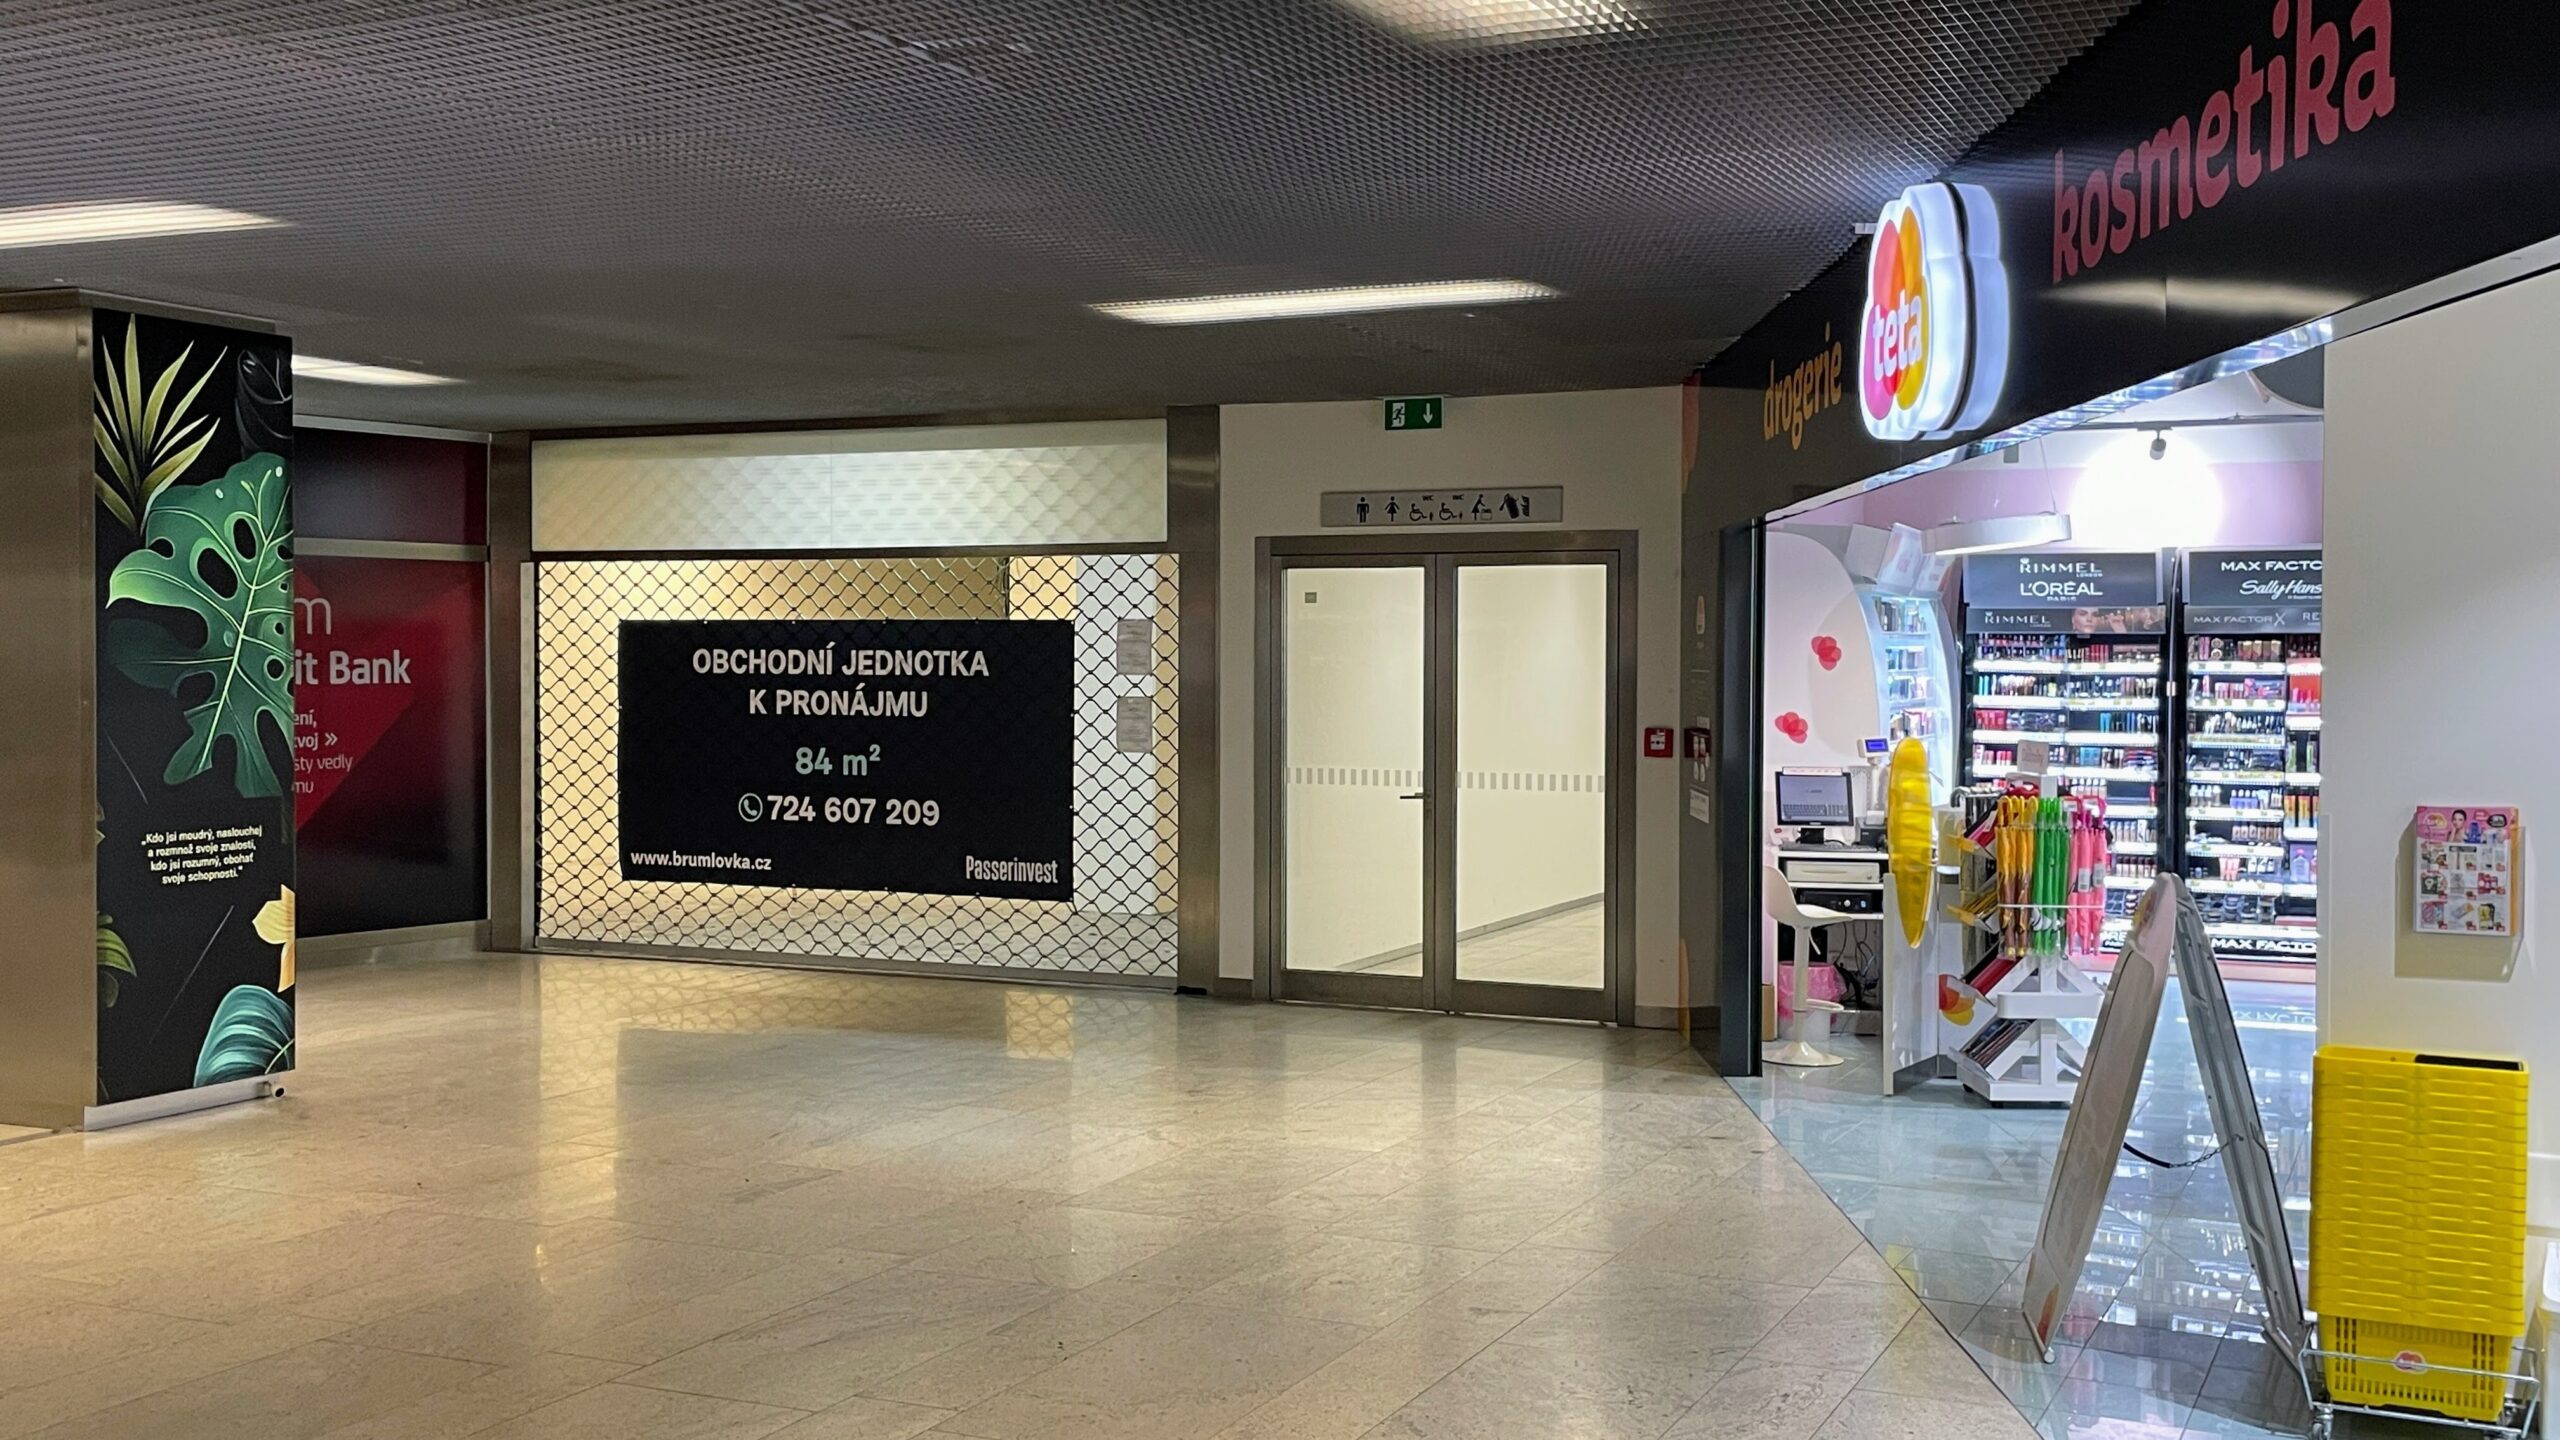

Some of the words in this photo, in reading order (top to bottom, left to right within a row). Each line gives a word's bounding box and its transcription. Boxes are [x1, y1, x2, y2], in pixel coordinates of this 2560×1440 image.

[2053, 0, 2396, 285] kosmetika
[1872, 289, 1923, 382] teta
[1763, 321, 1842, 450] drogerie
[2019, 562, 2103, 574] RIMMEL
[2220, 561, 2261, 572] MAX
[2240, 579, 2285, 601] Sally
[1984, 614, 2051, 624] RIMMEL
[2193, 615, 2221, 624] MAX
[2224, 615, 2273, 624] FACTOR
[329, 649, 412, 685] Bank
[692, 640, 836, 676] OBCHODNÍ
[841, 649, 990, 677] JEDNOTKA
[749, 689, 768, 715] K
[775, 682, 928, 718] PRONÁJMU
[294, 732, 319, 752] voj
[317, 753, 353, 772] vedly
[795, 746, 834, 775] 84
[842, 743, 881, 776] m²
[767, 794, 816, 822] 724
[824, 796, 877, 824] 607
[885, 798, 940, 827] 209
[165, 831, 177, 844] jsi
[216, 825, 262, 837] naslouchej
[147, 849, 154, 857] a
[156, 843, 193, 857] rozmnož
[195, 842, 218, 854] svoje
[150, 861, 168, 871] kdo
[169, 858, 180, 872] jsi
[630, 850, 772, 870] www.brumlovka.cz
[965, 855, 1059, 883] Passerinvest
[162, 872, 185, 885] svoje
[2211, 938, 2254, 950] MAX
